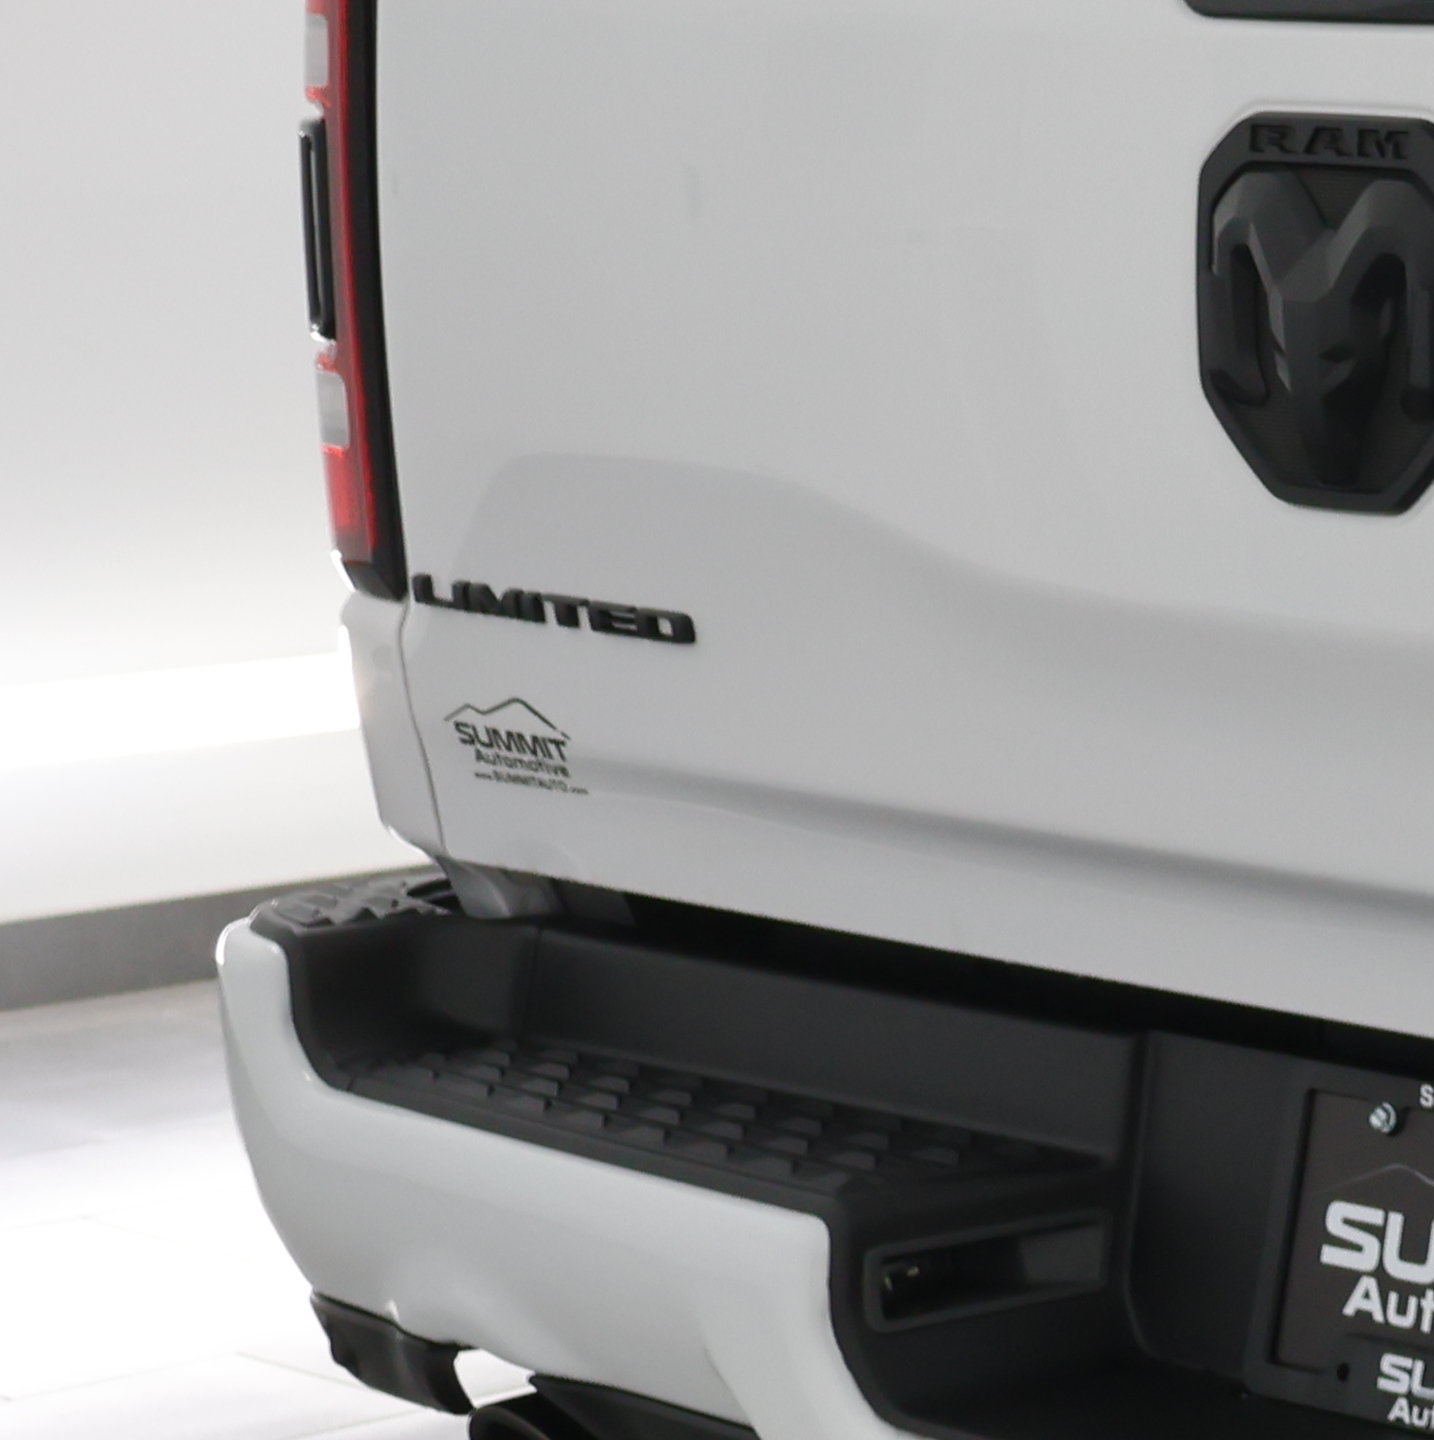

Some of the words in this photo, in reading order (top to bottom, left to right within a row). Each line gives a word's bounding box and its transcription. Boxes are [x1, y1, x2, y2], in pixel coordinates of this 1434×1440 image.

[1248, 122, 1410, 161] RAM
[411, 573, 696, 644] LIMITED
[453, 720, 567, 762] SUMMIT
[474, 747, 571, 779] Automotive
